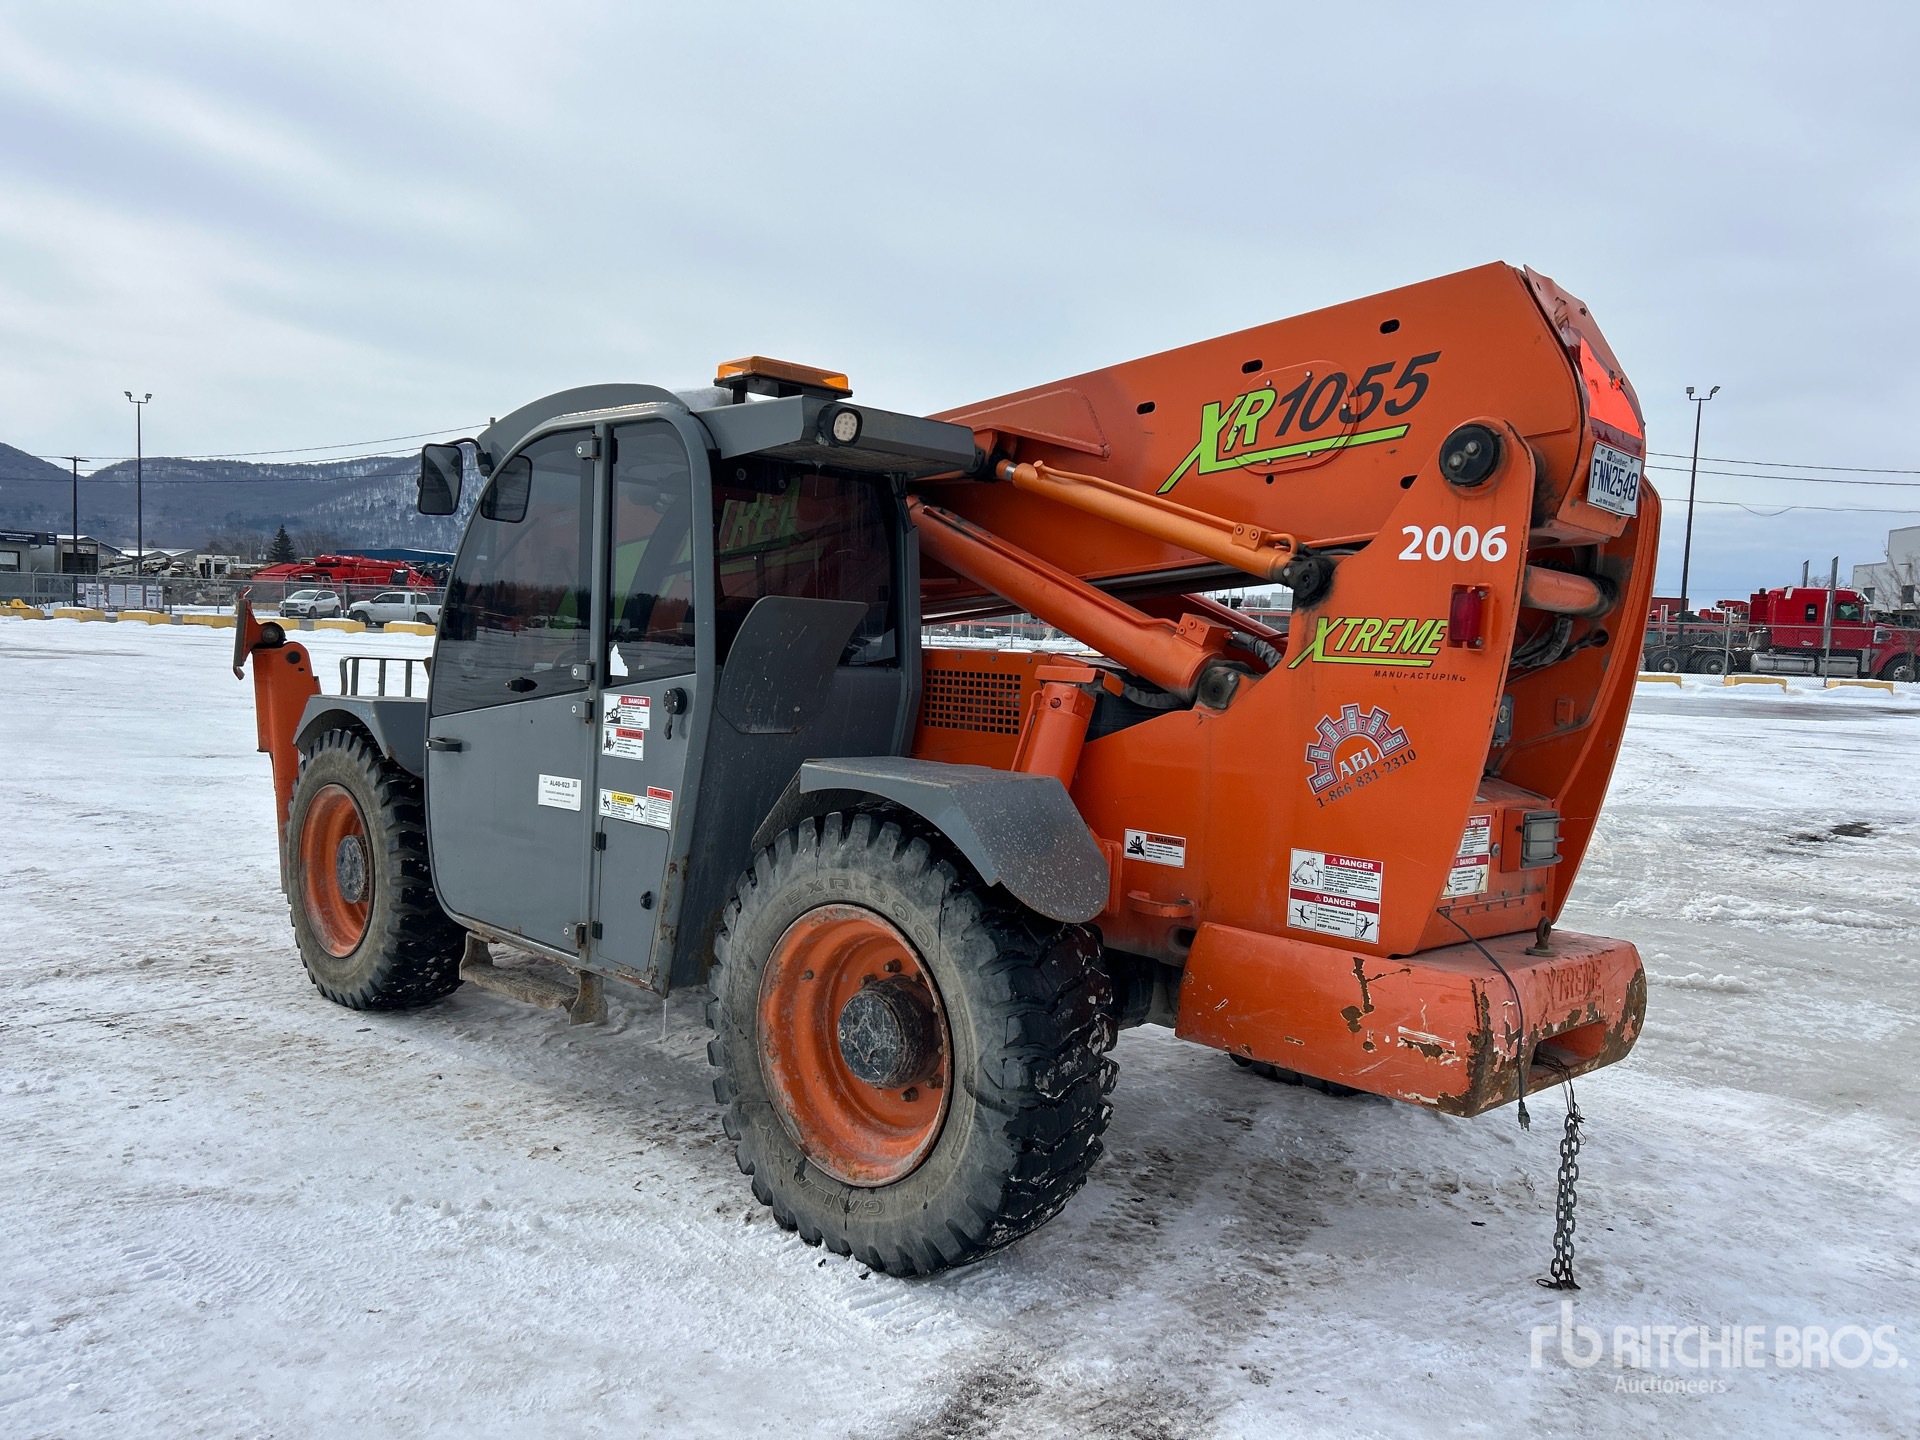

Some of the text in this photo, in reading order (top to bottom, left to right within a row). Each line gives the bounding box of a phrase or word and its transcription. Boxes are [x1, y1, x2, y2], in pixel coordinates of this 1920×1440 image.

[1274, 351, 1442, 437] 1055
[1591, 458, 1639, 502] FNN2548
[1398, 525, 1508, 562] 2006
[1287, 616, 1448, 669] XTREME
[1316, 748, 1417, 809] 1-866-831-2310
[1338, 747, 1380, 781] ABL
[616, 794, 634, 803] CAUTION
[1155, 836, 1182, 845] WARNING
[1339, 858, 1374, 870] DANGER
[1322, 896, 1357, 908] DANGER
